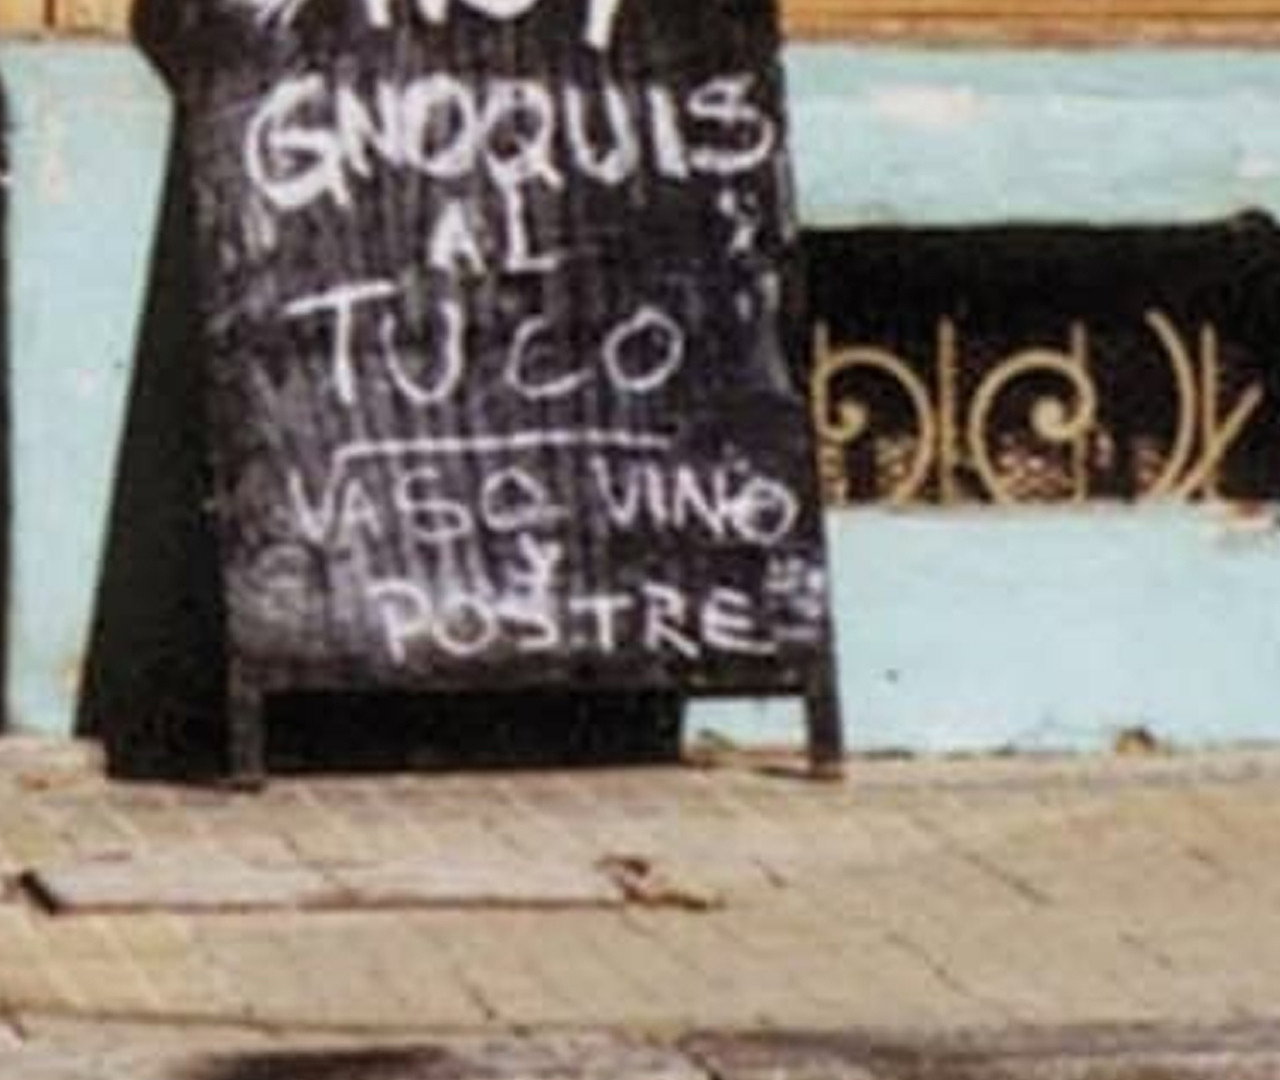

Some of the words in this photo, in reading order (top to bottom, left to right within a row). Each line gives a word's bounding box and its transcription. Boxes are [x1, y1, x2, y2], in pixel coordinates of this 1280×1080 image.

[246, 73, 775, 208] GNOQUIS
[430, 184, 560, 272] AL
[286, 280, 682, 404] TUCO
[290, 465, 550, 541] VASO
[593, 458, 798, 542] VINO
[365, 580, 775, 662] POSTRE
